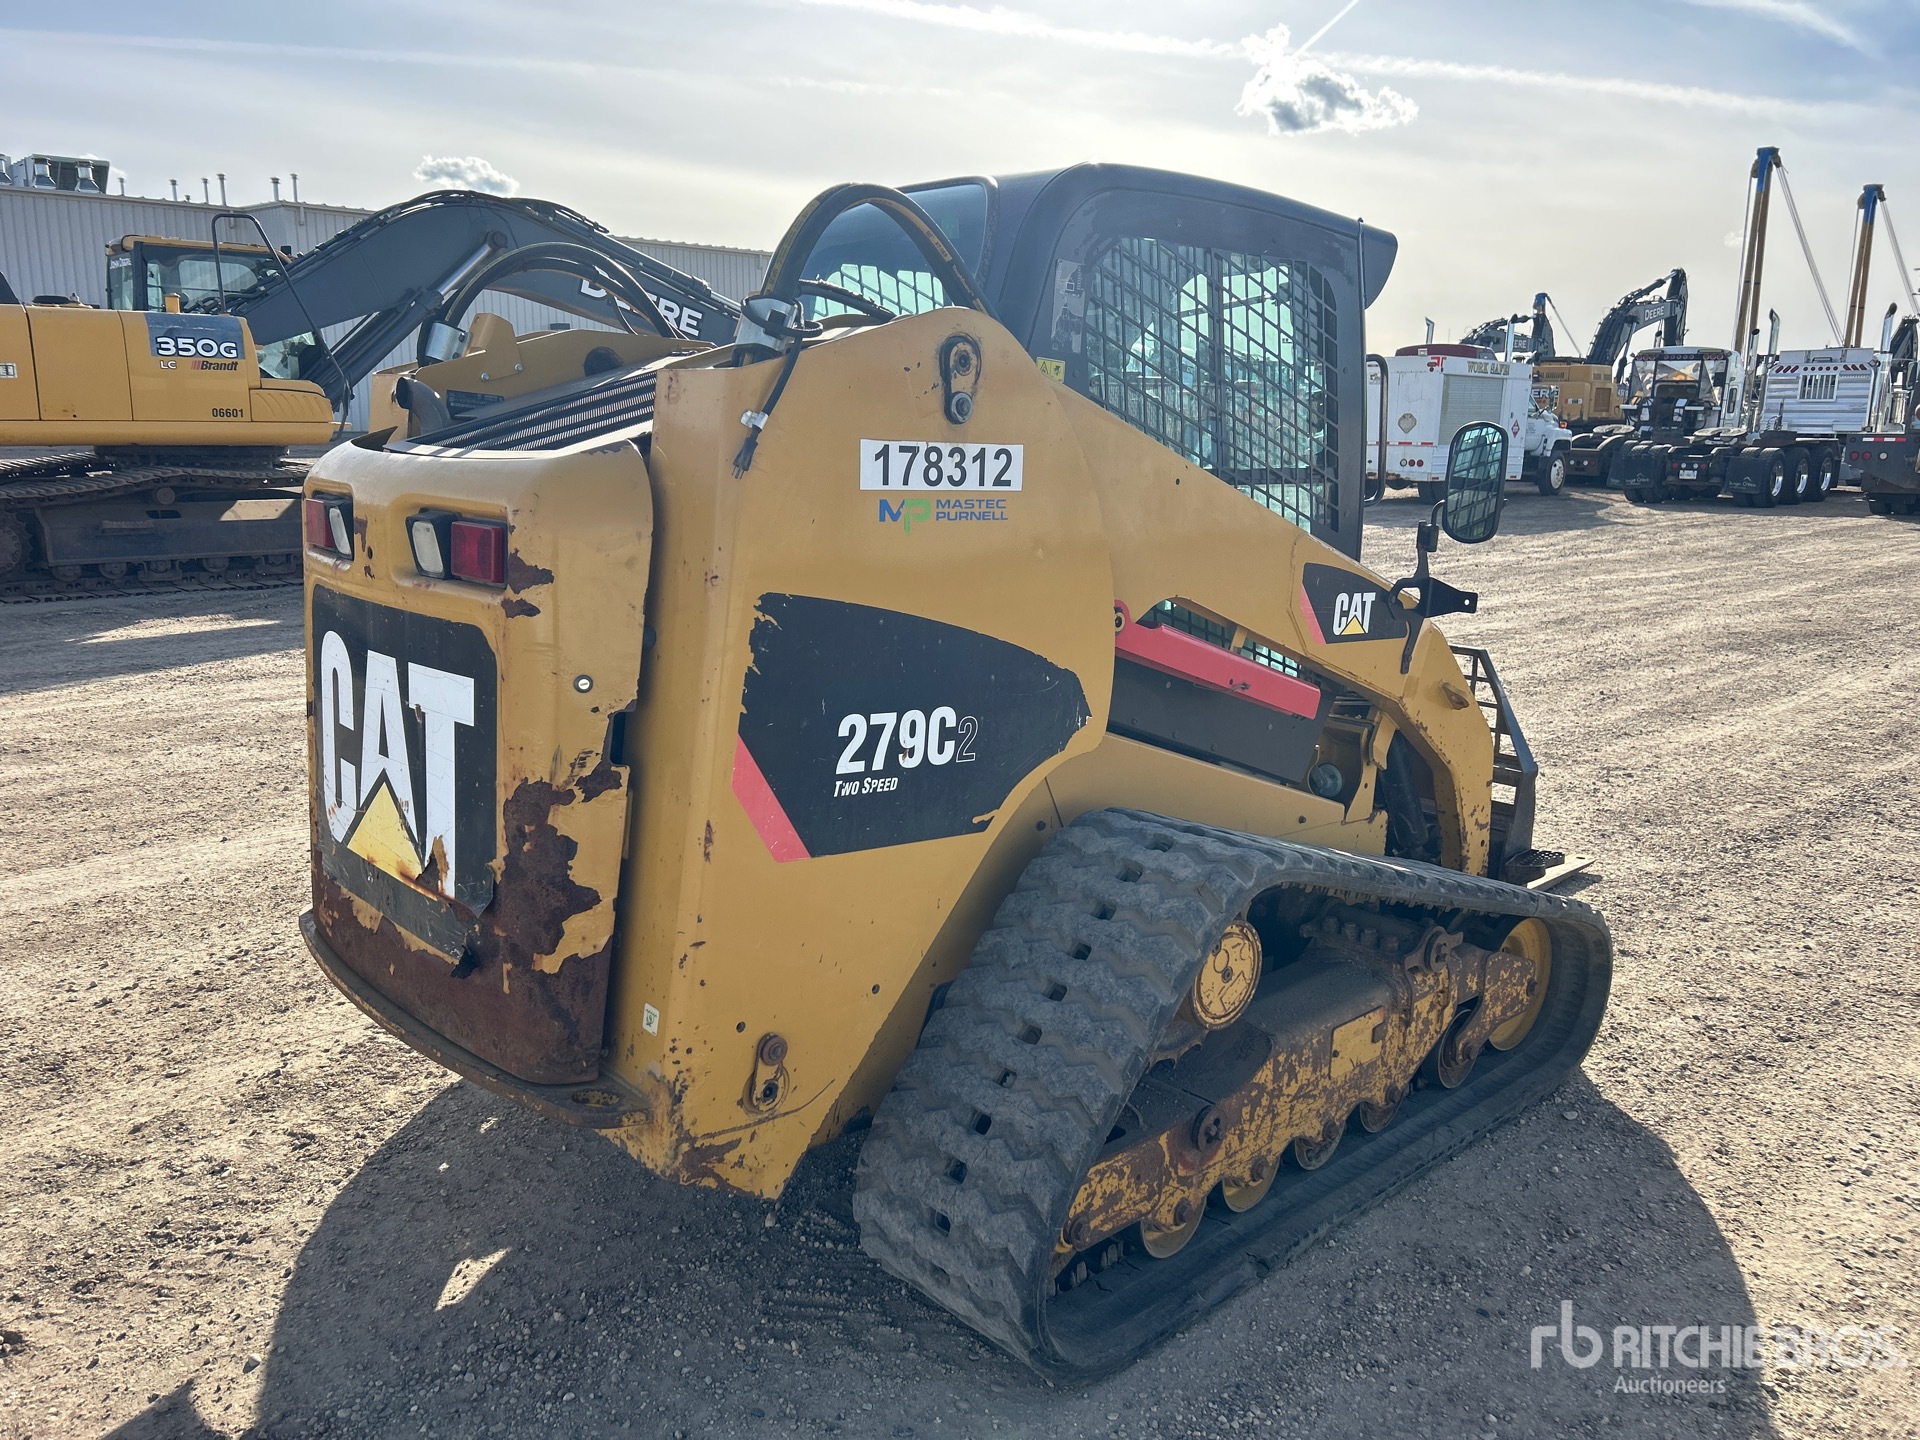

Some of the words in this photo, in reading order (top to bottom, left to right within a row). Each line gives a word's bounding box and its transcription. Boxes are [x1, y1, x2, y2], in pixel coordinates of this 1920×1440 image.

[580, 265, 703, 337] DRE
[1644, 305, 1665, 321] DEERE
[156, 336, 238, 358] 350G
[1512, 339, 1527, 349] ERE
[160, 360, 177, 369] LC
[200, 360, 238, 371] Brandt
[1467, 360, 1489, 374] WORK
[211, 407, 244, 418] 06601
[874, 443, 1013, 487] 178312
[935, 499, 1007, 509] MASTEC
[935, 511, 1009, 521] PURNELL
[1332, 591, 1376, 636] CAT
[320, 630, 475, 900] CAT
